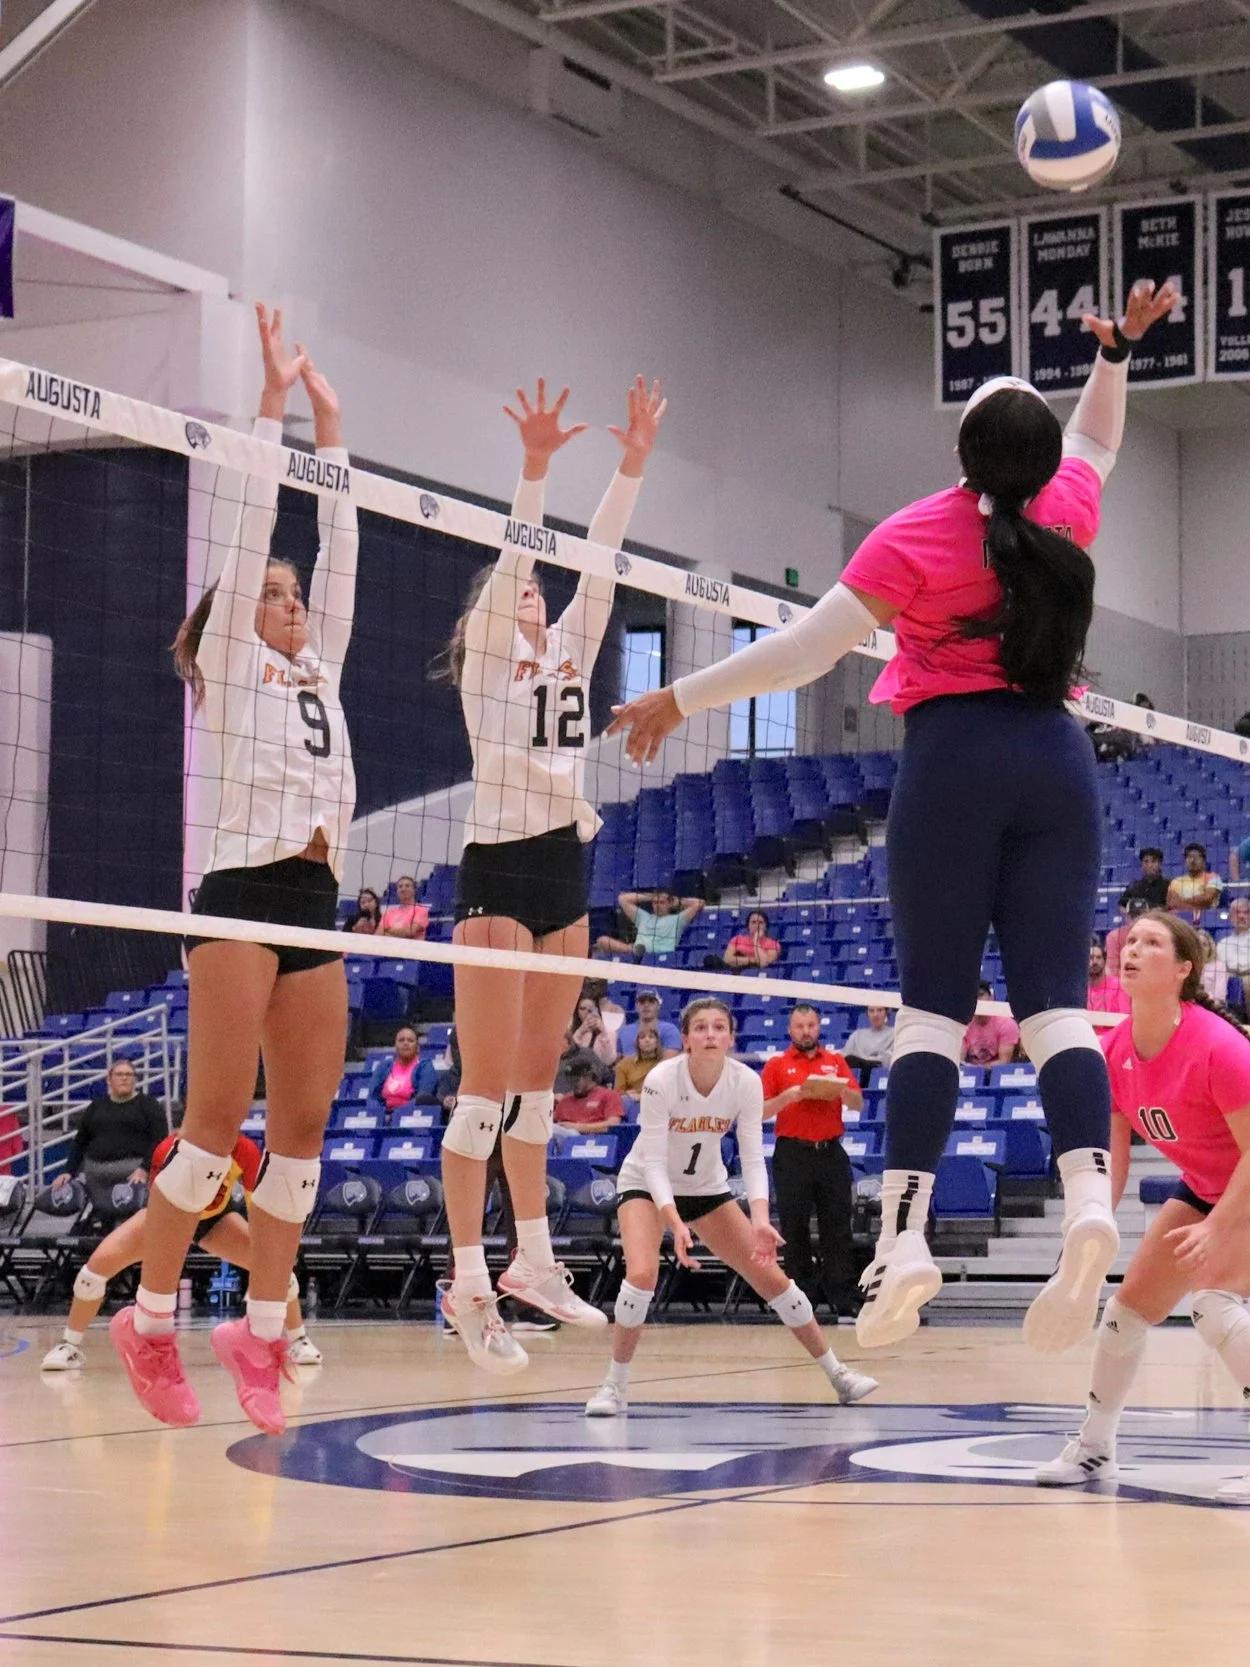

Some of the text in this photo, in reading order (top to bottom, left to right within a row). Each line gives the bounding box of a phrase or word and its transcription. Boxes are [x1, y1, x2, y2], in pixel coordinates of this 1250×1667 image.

[1141, 217, 1177, 232] BETH
[946, 298, 1007, 348] 55
[1030, 286, 1100, 338] 44
[25, 370, 101, 420] AUGUSTA
[287, 452, 350, 494] AUGUSTA
[503, 519, 557, 557] AUGUSTA
[685, 573, 730, 607] AUGUSTA
[297, 691, 331, 758] 9
[532, 685, 585, 748] 12
[1085, 695, 1115, 719] AUGUSTA
[1186, 723, 1212, 745] AUGUSTA
[1138, 1106, 1178, 1141] 10
[683, 1143, 702, 1175] 1
